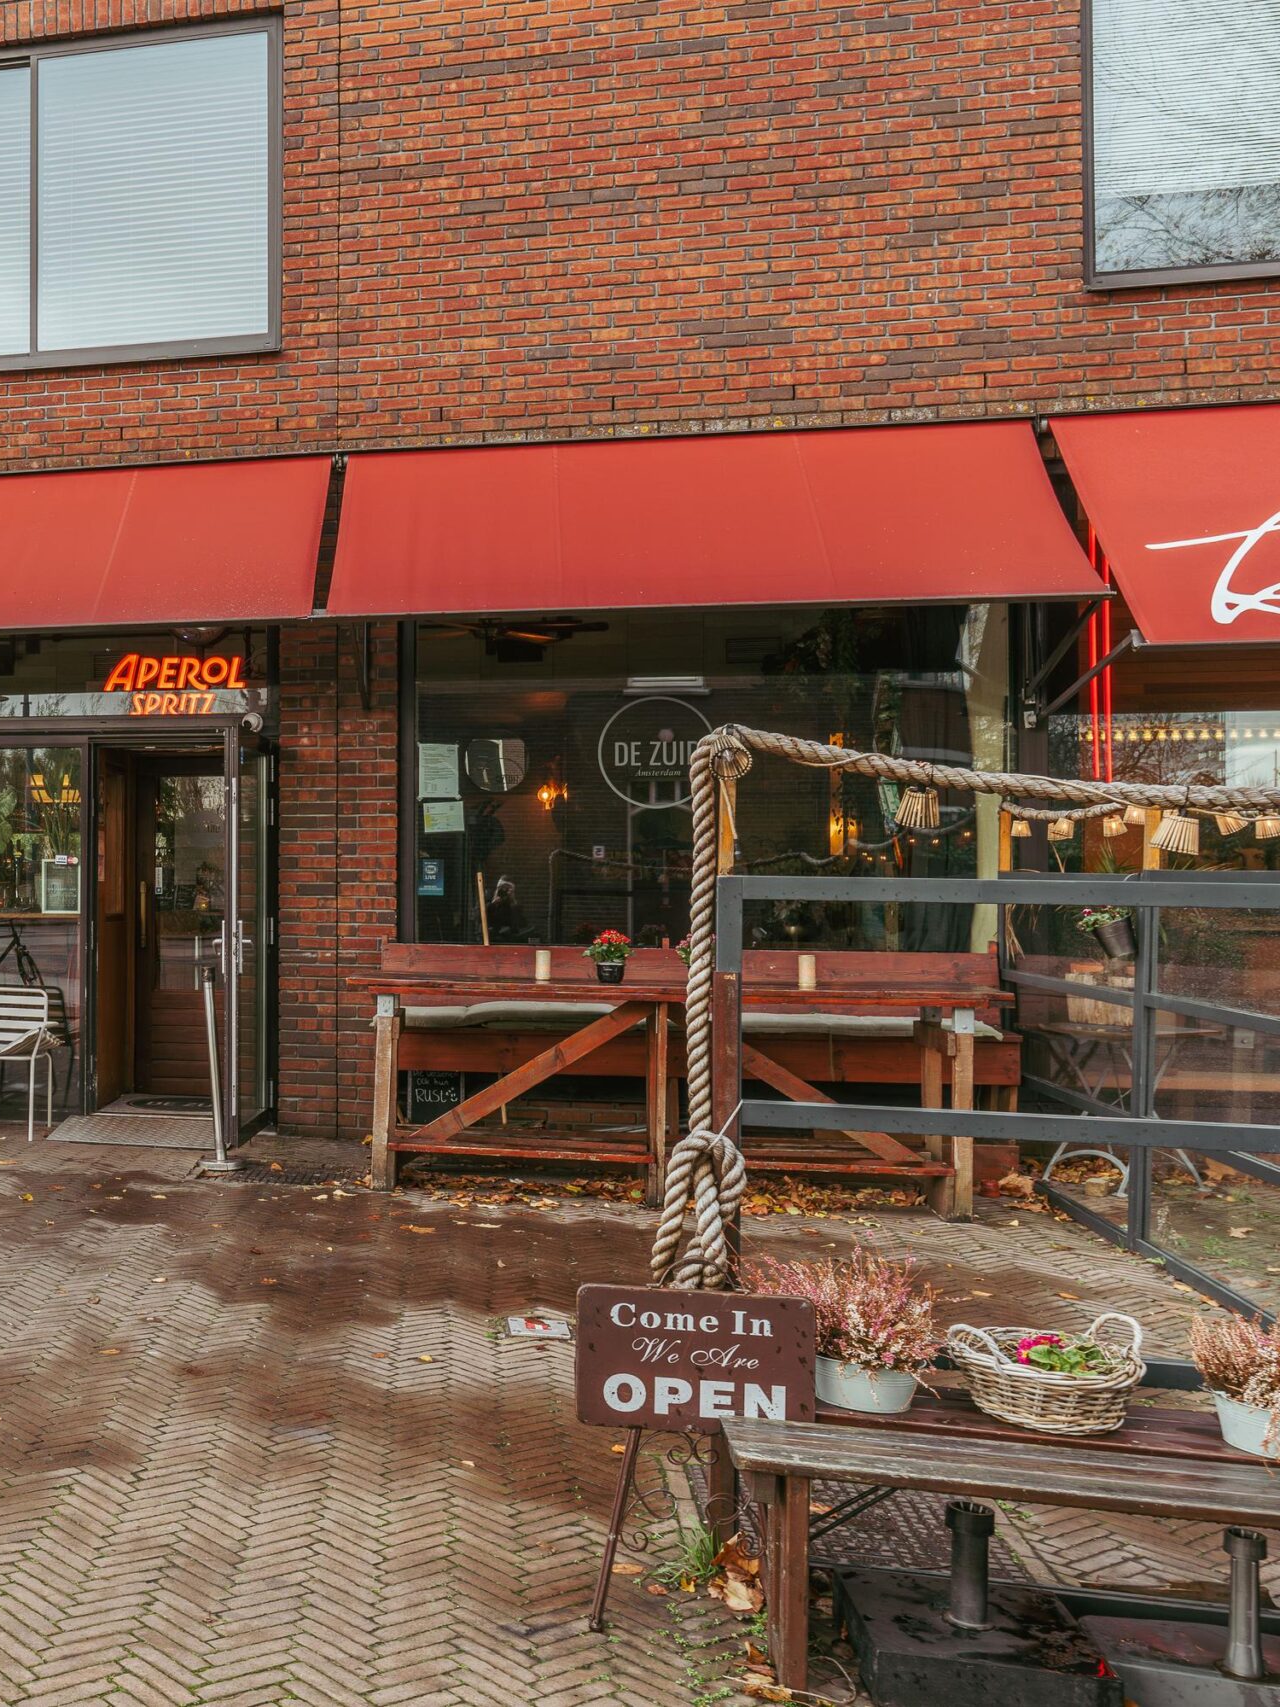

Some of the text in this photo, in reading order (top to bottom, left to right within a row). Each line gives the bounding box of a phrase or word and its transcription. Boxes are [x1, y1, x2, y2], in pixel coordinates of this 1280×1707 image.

[103, 652, 247, 692] APEROL
[130, 693, 216, 716] SPRITZ
[614, 741, 641, 766] DE
[634, 768, 681, 777] Amsterdam
[609, 1302, 774, 1337] Come In
[631, 1337, 760, 1370] We Are
[602, 1372, 787, 1421] OPEN
